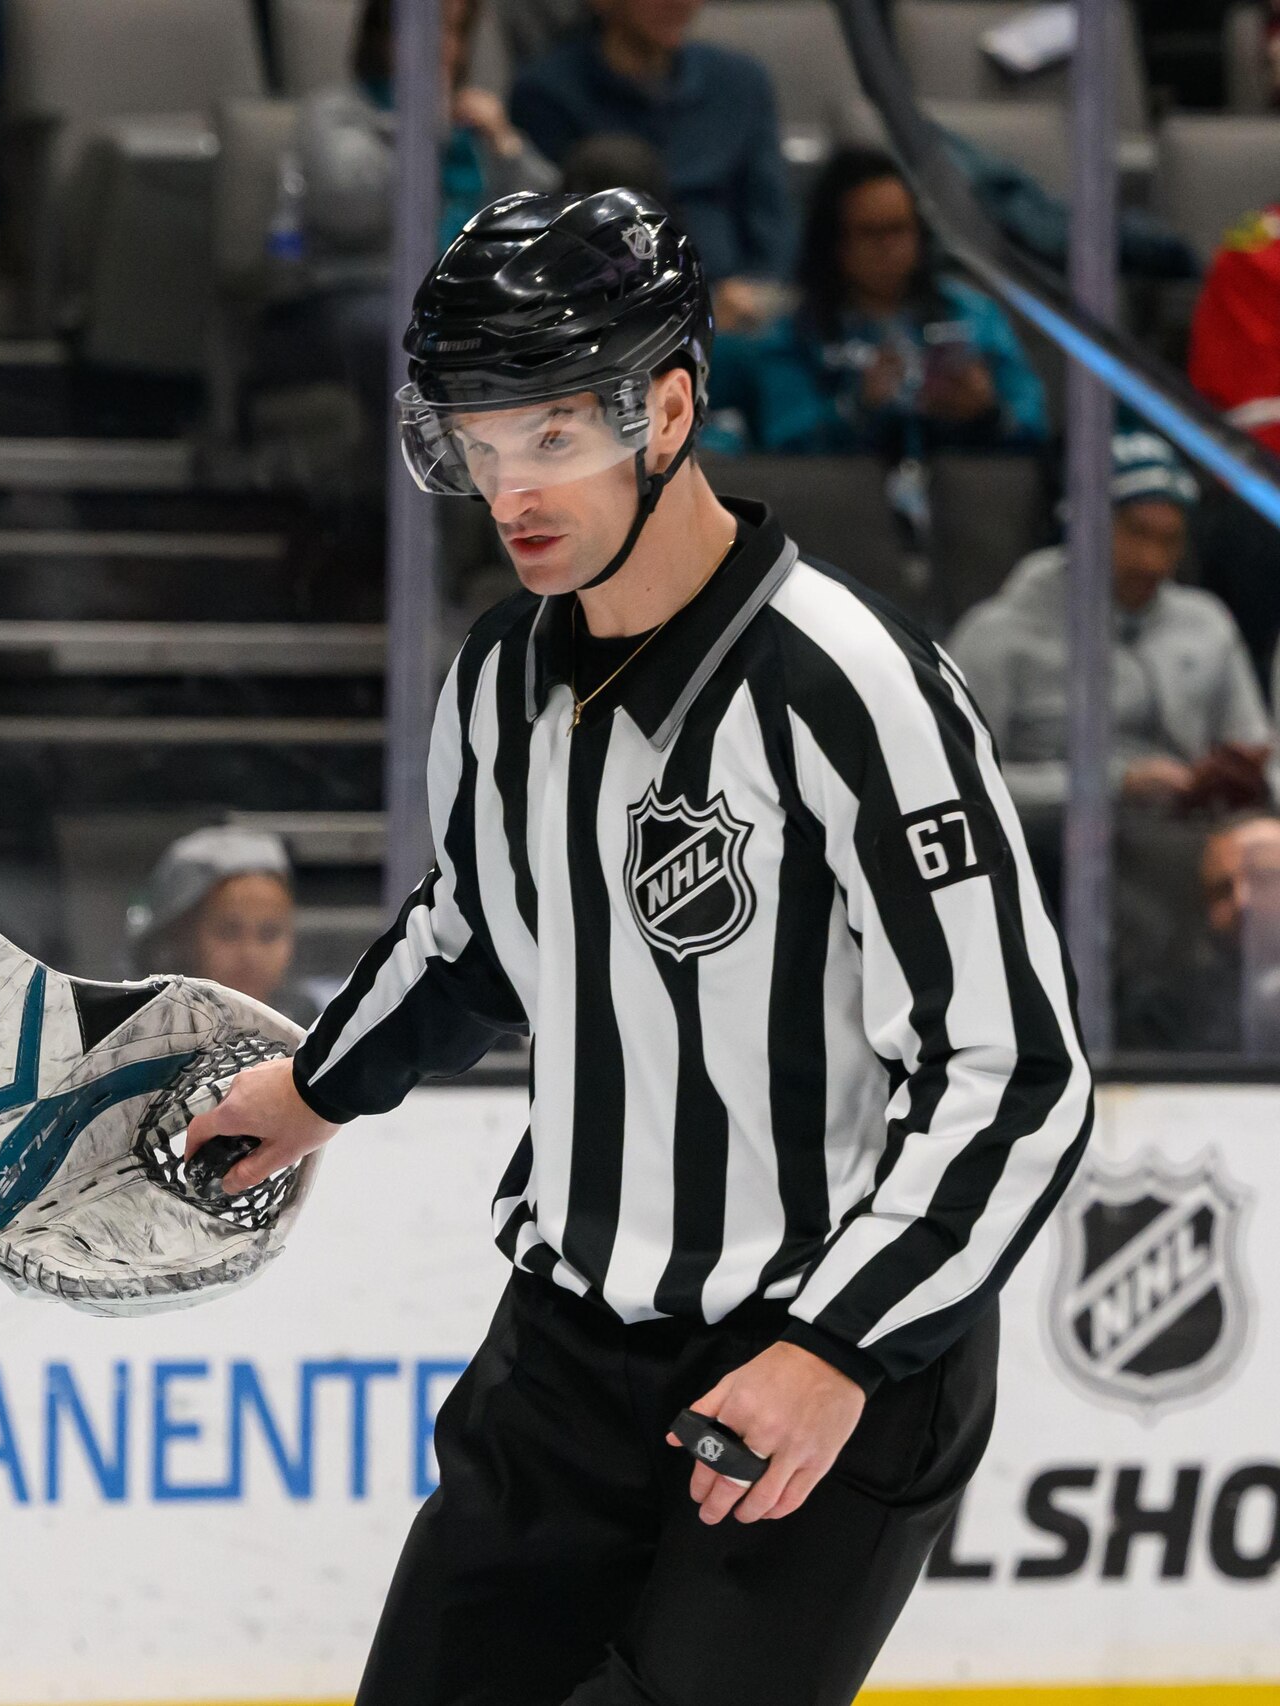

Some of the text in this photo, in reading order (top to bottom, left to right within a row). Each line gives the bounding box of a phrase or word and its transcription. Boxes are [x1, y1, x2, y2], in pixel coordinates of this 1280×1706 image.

[646, 841, 719, 917] NHL
[905, 810, 978, 880] 67
[1091, 1219, 1211, 1357] NHL
